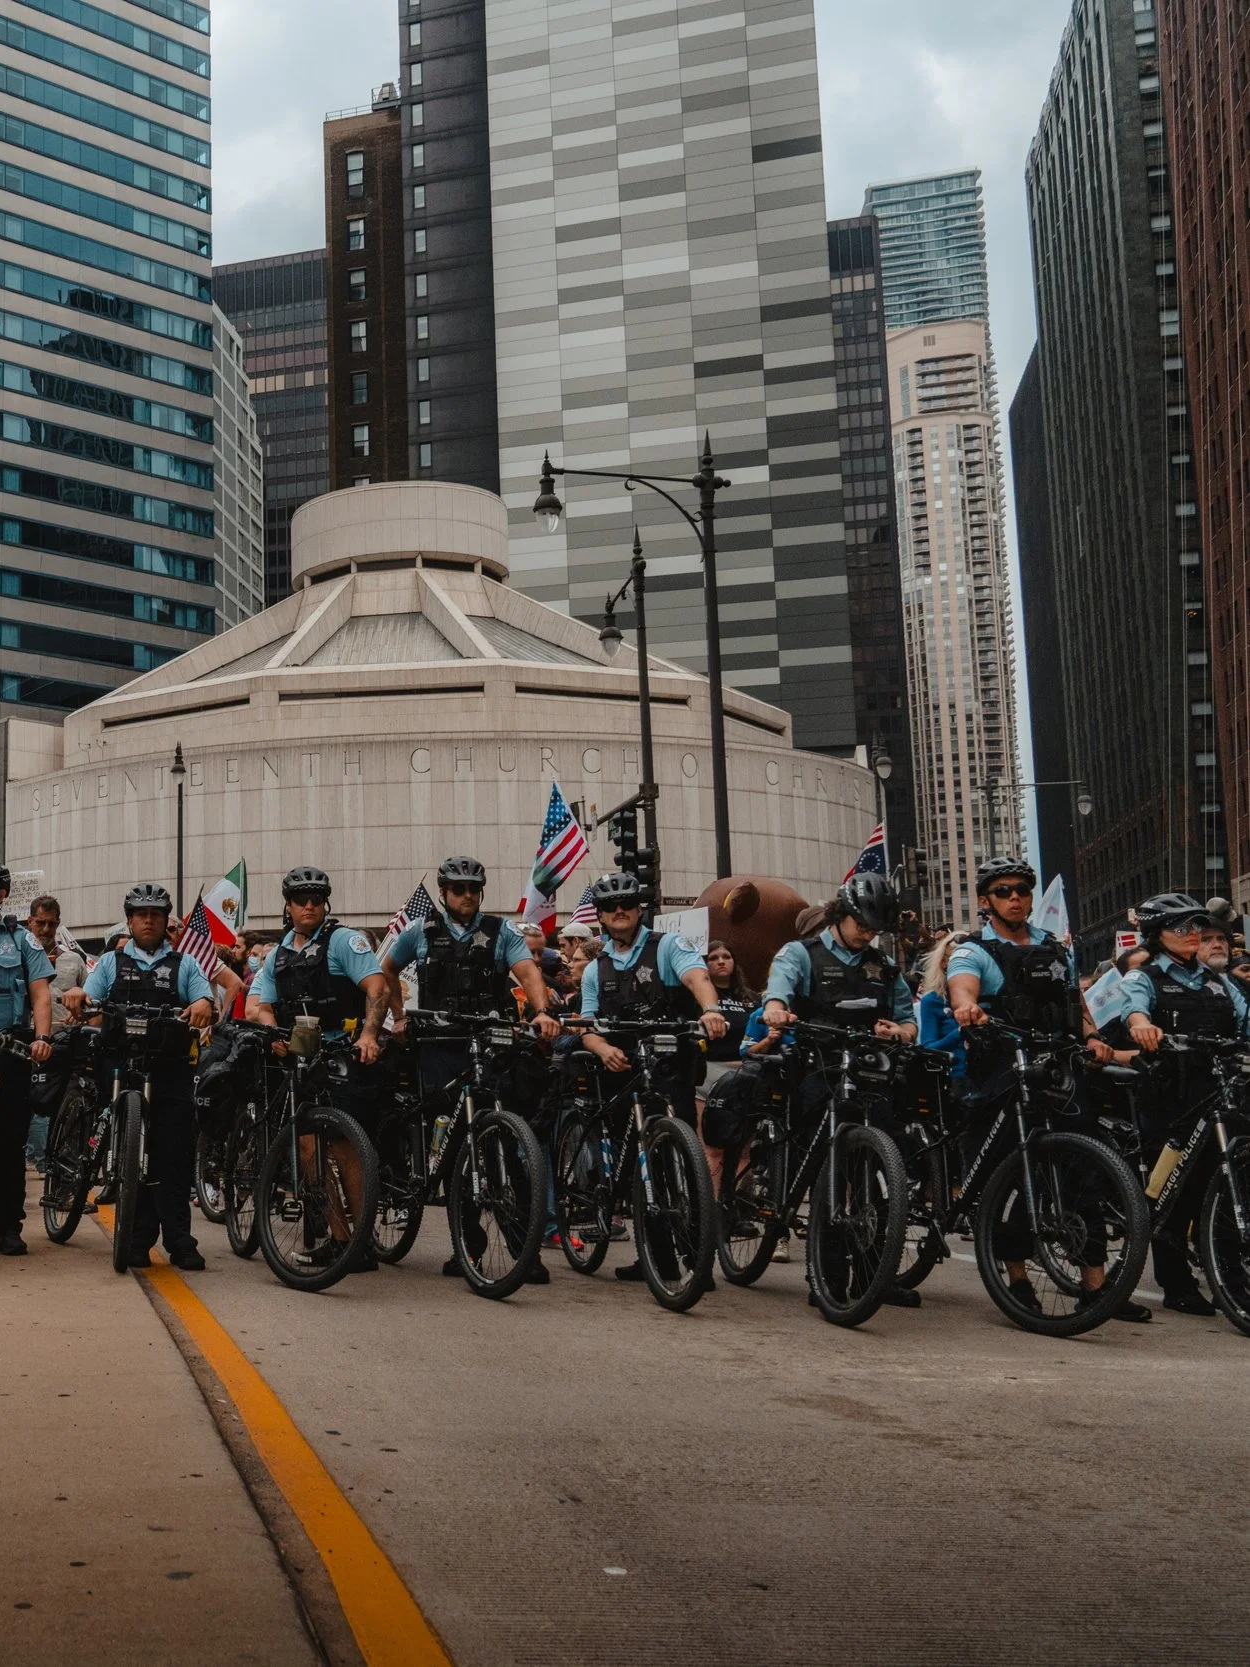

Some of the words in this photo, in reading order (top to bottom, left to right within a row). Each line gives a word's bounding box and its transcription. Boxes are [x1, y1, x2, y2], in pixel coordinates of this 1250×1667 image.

[31, 750, 363, 812] SEVENTEENTH
[409, 746, 640, 776] CHURCH
[432, 1135, 449, 1175] CHICAGO
[958, 1155, 982, 1200] CHICAGO
[980, 1121, 1001, 1157] POLICE
[1154, 1167, 1180, 1211] CHICAGO
[1178, 1128, 1201, 1168] POLICE
